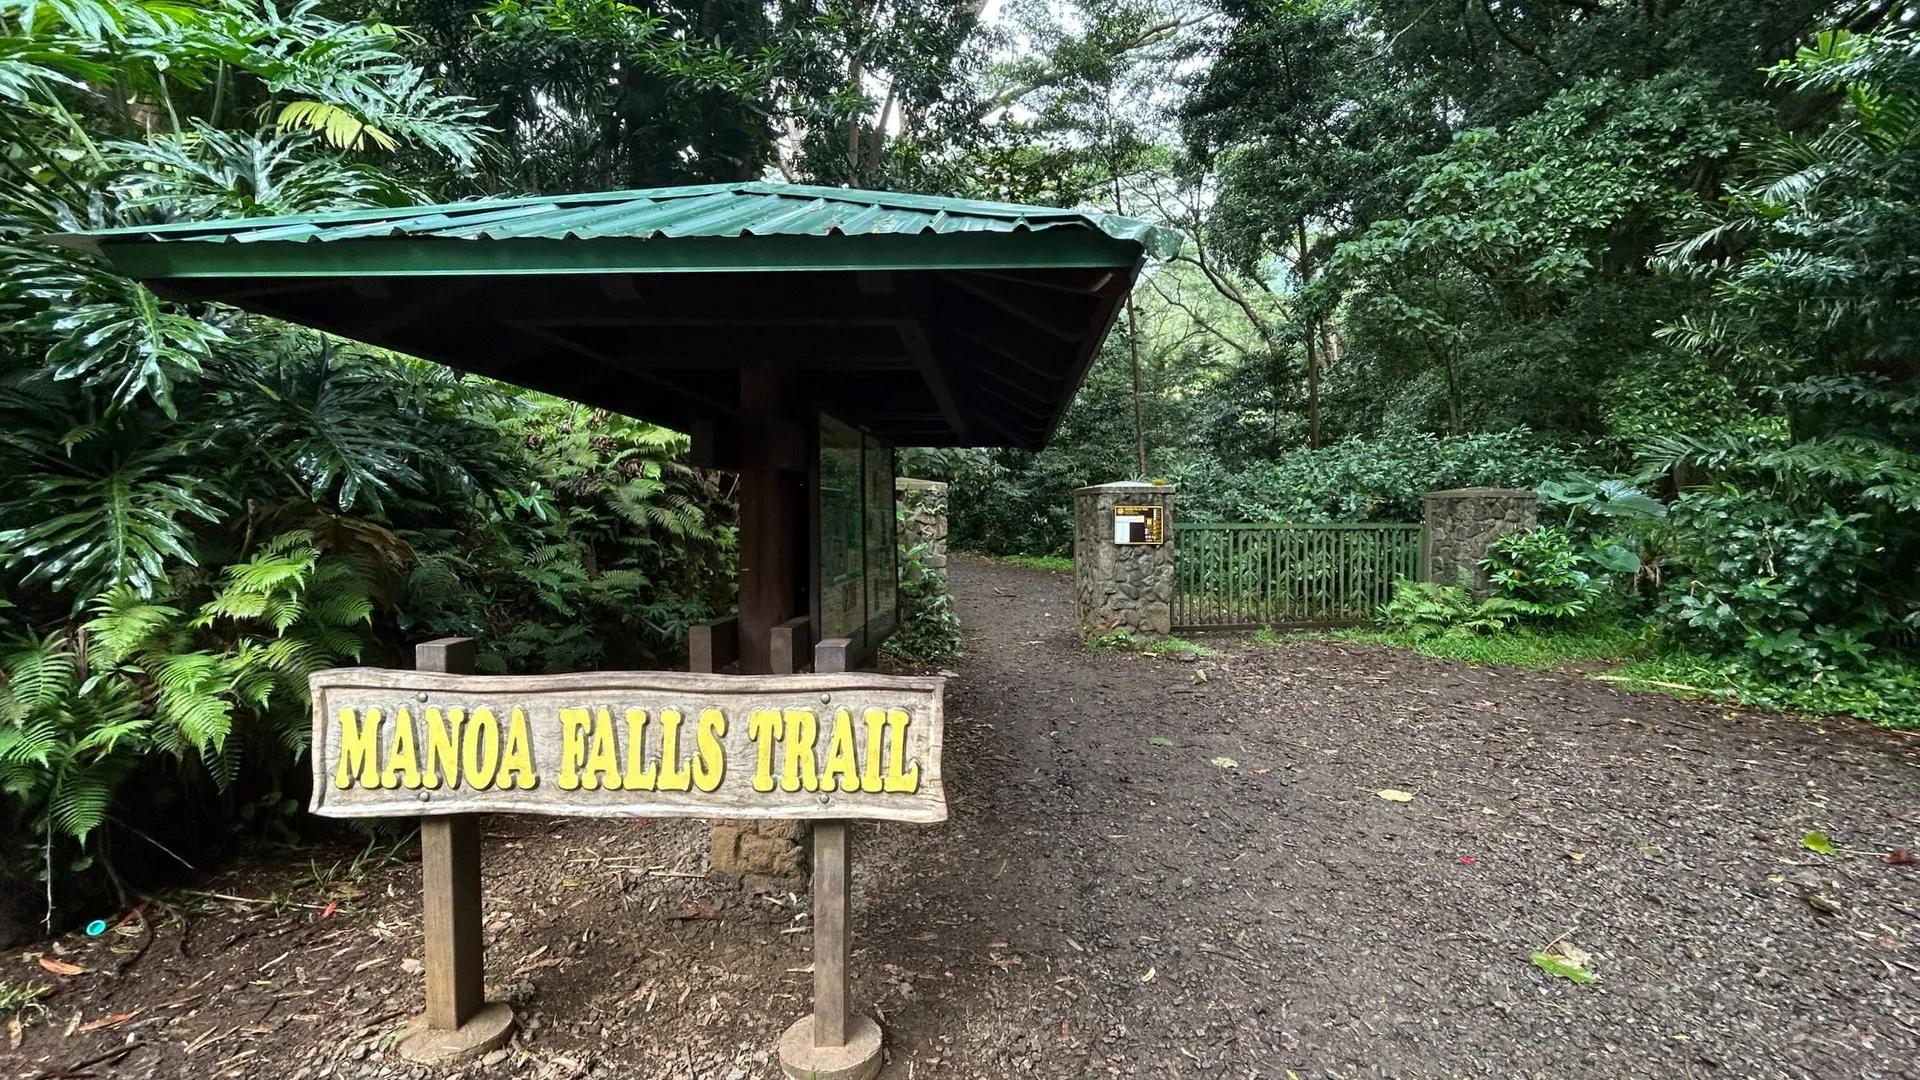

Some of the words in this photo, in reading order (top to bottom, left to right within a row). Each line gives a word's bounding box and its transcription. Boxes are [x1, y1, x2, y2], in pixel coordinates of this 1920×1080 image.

[335, 708, 538, 790] MANOA
[558, 708, 727, 792] FALLS
[749, 709, 920, 793] TRAIL
